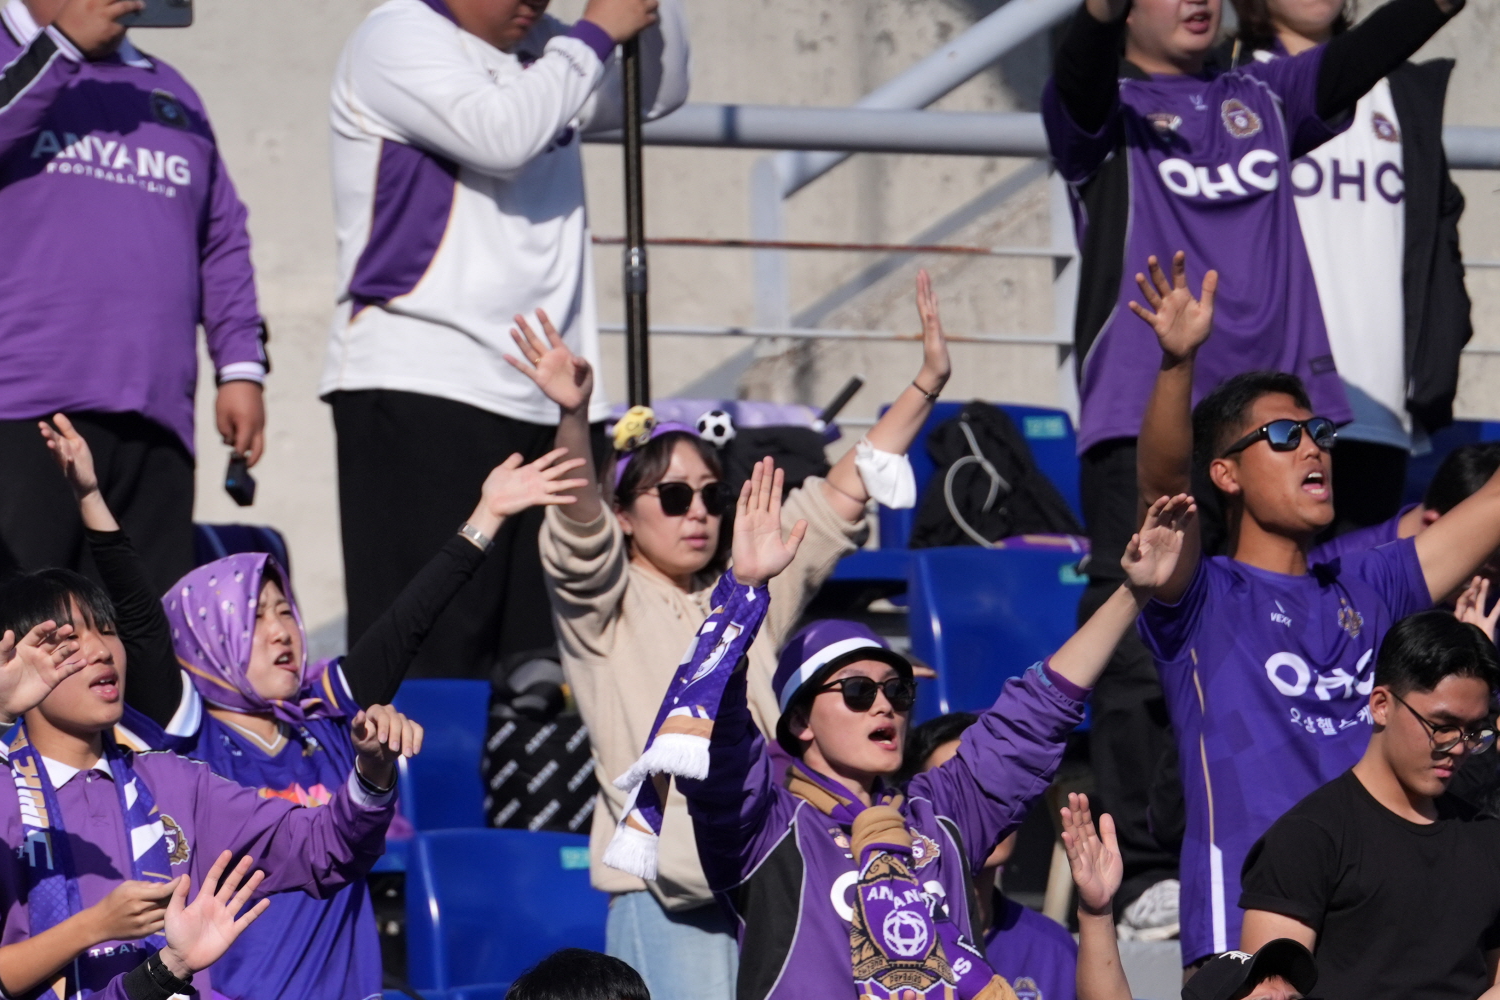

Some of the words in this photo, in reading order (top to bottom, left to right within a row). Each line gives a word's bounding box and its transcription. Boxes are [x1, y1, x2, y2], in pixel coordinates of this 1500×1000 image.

[30, 130, 191, 185] ANYANG
[1159, 149, 1279, 199] OHC
[1291, 156, 1405, 204] OHC
